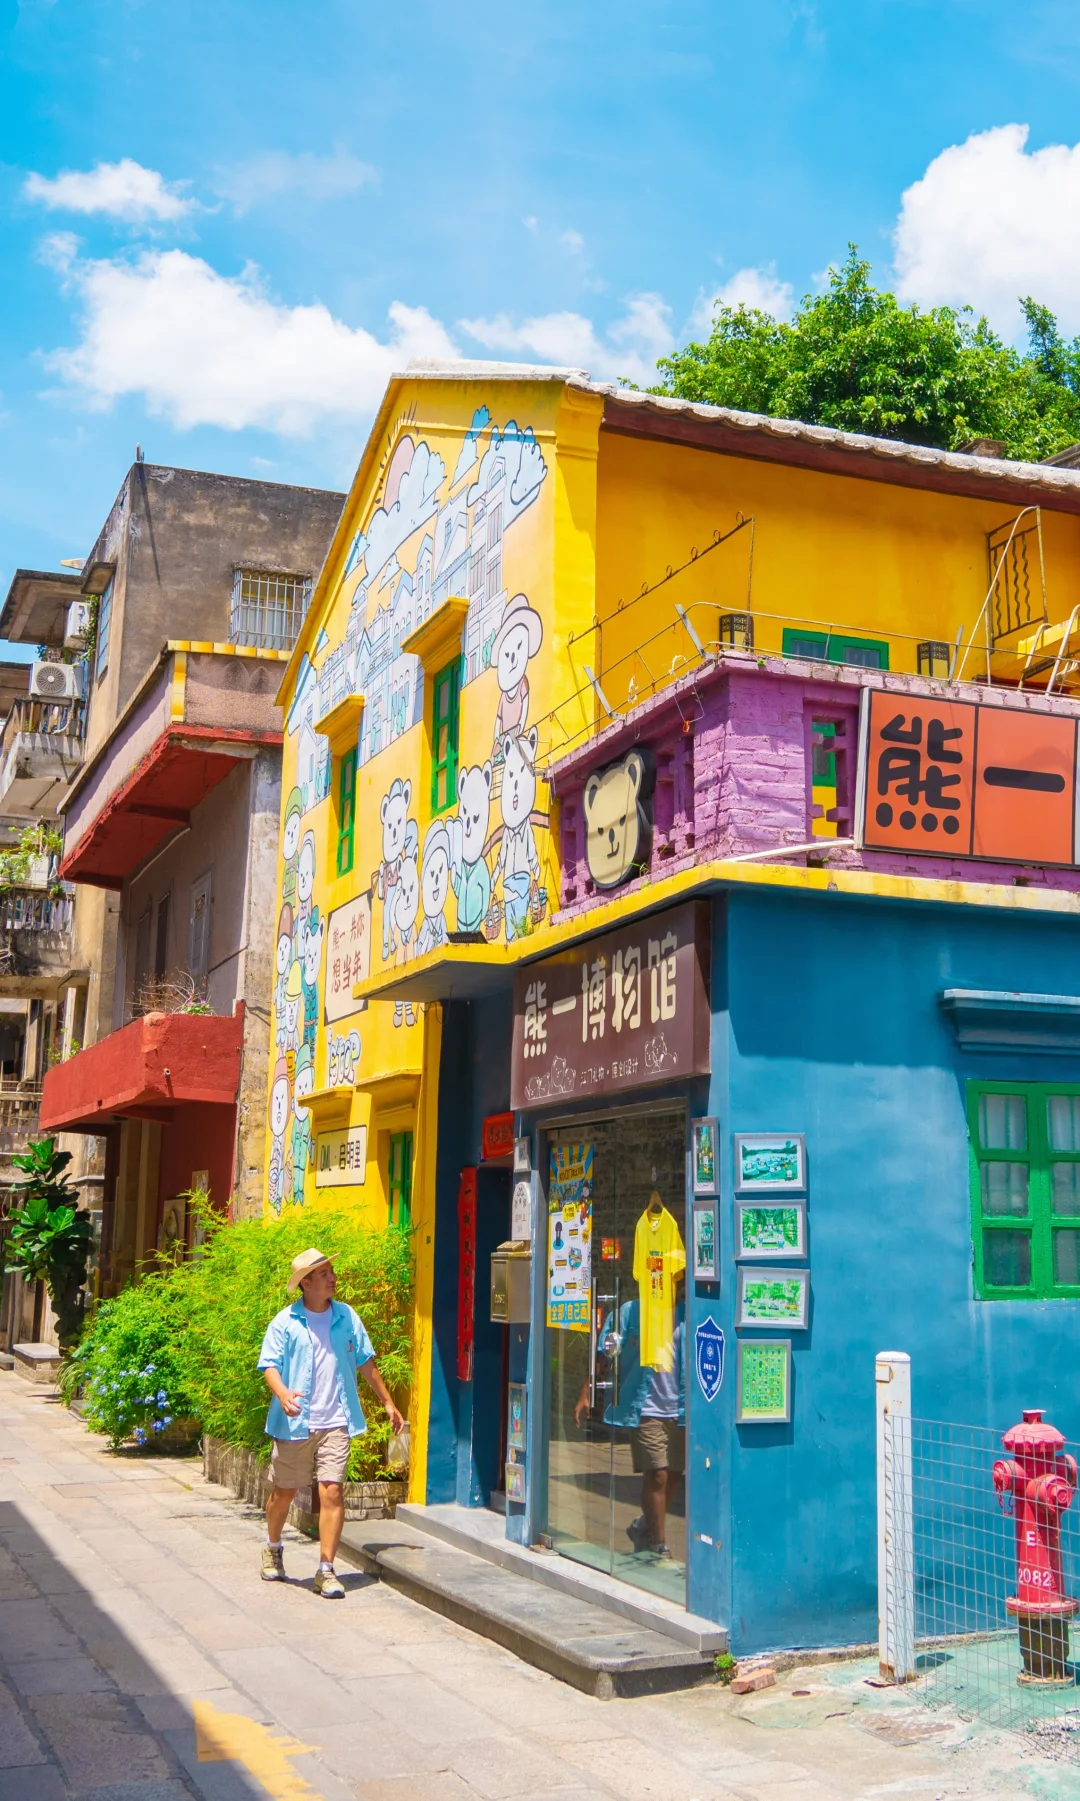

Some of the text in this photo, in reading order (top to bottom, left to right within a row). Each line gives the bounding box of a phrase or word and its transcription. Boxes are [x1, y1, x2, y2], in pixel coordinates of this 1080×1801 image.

[876, 714, 1066, 834] 熊一
[331, 950, 361, 993] 想当年
[524, 931, 677, 1059] 熊一博物馆
[1027, 1531, 1036, 1547] E
[1018, 1568, 1052, 1587] 2082
